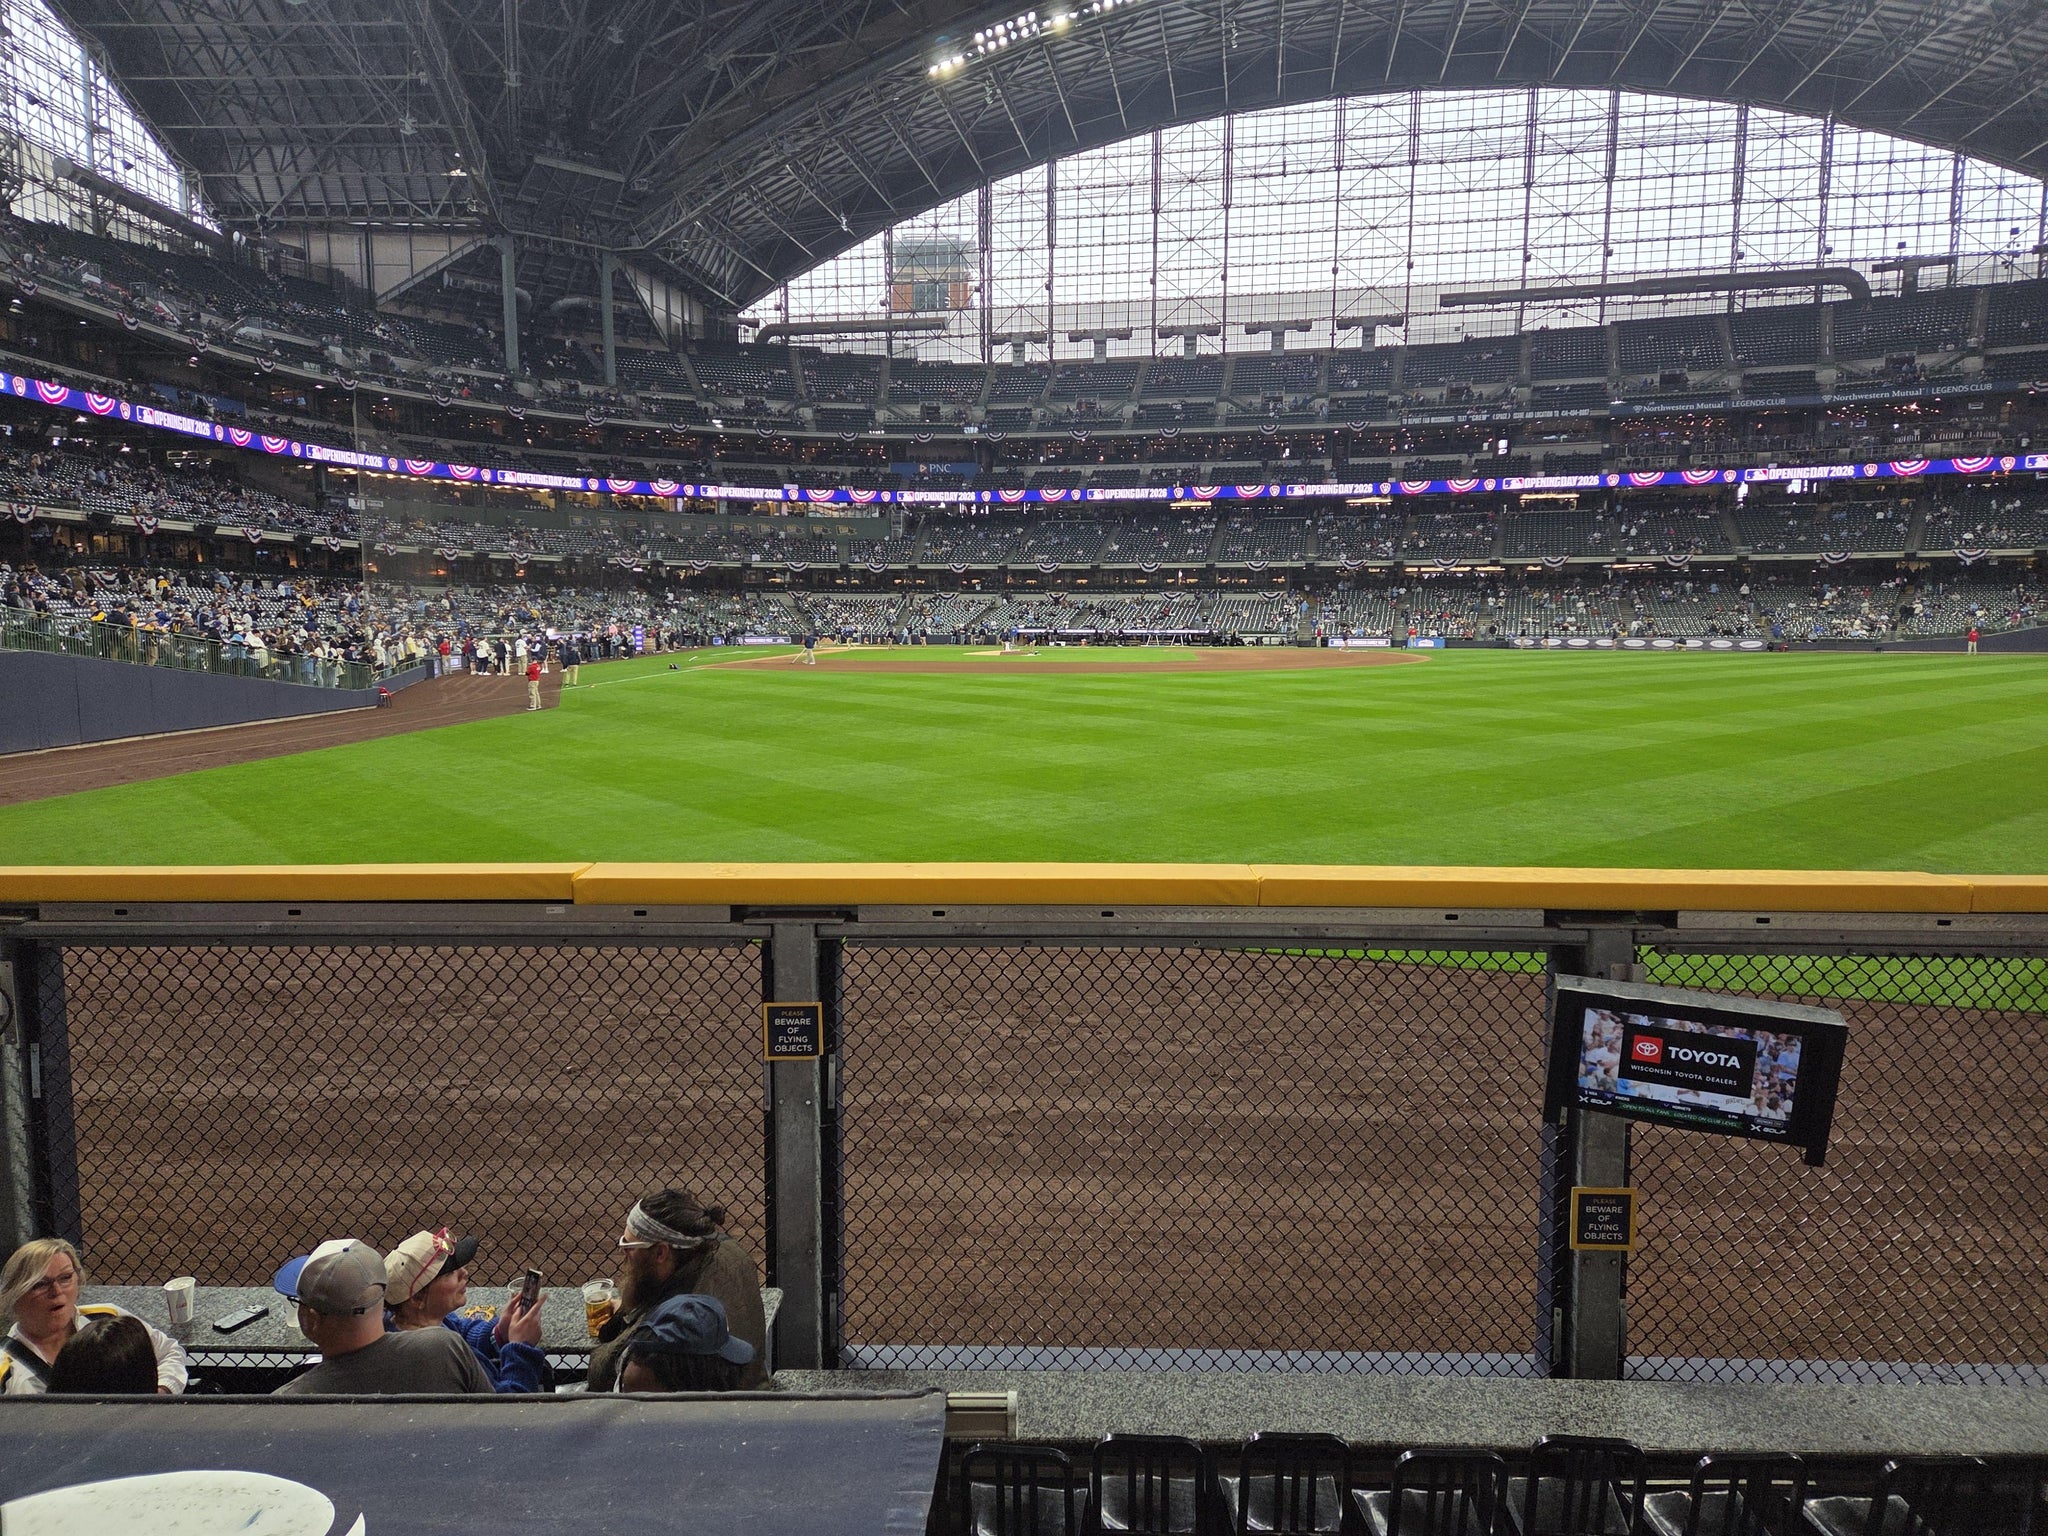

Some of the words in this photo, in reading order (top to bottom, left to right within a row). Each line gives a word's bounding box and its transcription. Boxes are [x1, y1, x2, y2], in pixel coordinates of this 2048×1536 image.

[1832, 392, 1890, 402] Northwestern
[1892, 389, 1922, 398] Mutual
[1932, 385, 1969, 394] LEGENDS
[1970, 383, 1992, 392] CLUB
[1643, 403, 1695, 413] Northwestern
[1696, 401, 1724, 409] Mutual
[1732, 399, 1765, 408] LEGENDS
[1766, 398, 1786, 406] CLUB
[154, 410, 183, 430] OPENING
[183, 417, 194, 432] DAY
[195, 421, 210, 436] 2026
[322, 448, 351, 464] OPENING
[365, 456, 382, 467] 2026
[930, 464, 951, 473] PNC
[1769, 467, 1810, 479] OPENING
[1810, 466, 1829, 478] DAY
[1830, 465, 1854, 476] 2026
[517, 472, 549, 485] OPENING
[549, 475, 562, 486] DAY
[563, 476, 581, 487] 2026
[1524, 476, 1561, 488] OPENING
[1561, 476, 1577, 487] DAY
[1578, 475, 1599, 486] 2026
[719, 487, 750, 498] OPENING
[750, 488, 764, 498] DAY
[764, 488, 782, 499] 2026
[1105, 489, 1135, 499] OPENING
[1136, 488, 1149, 498] DAY
[1150, 488, 1167, 498] 2026
[1306, 484, 1340, 495] OPENING
[1340, 484, 1354, 494] DAY
[1354, 484, 1373, 494] 2026
[914, 492, 944, 501] OPENING
[945, 492, 958, 501] DAY
[958, 492, 975, 501] 2026
[774, 1018, 811, 1026] BEWARE
[774, 1044, 812, 1052] OBJECTS
[1668, 1046, 1740, 1069] TOYOTA
[1630, 1064, 1672, 1076] WISCONSIN
[1675, 1072, 1703, 1081] TOYOTA
[1706, 1076, 1737, 1086] DEALERS
[1579, 1095, 1589, 1103] X
[1750, 1124, 1760, 1132] X
[1586, 1206, 1623, 1214] BEWARE
[1584, 1232, 1623, 1240] OBJECTS
